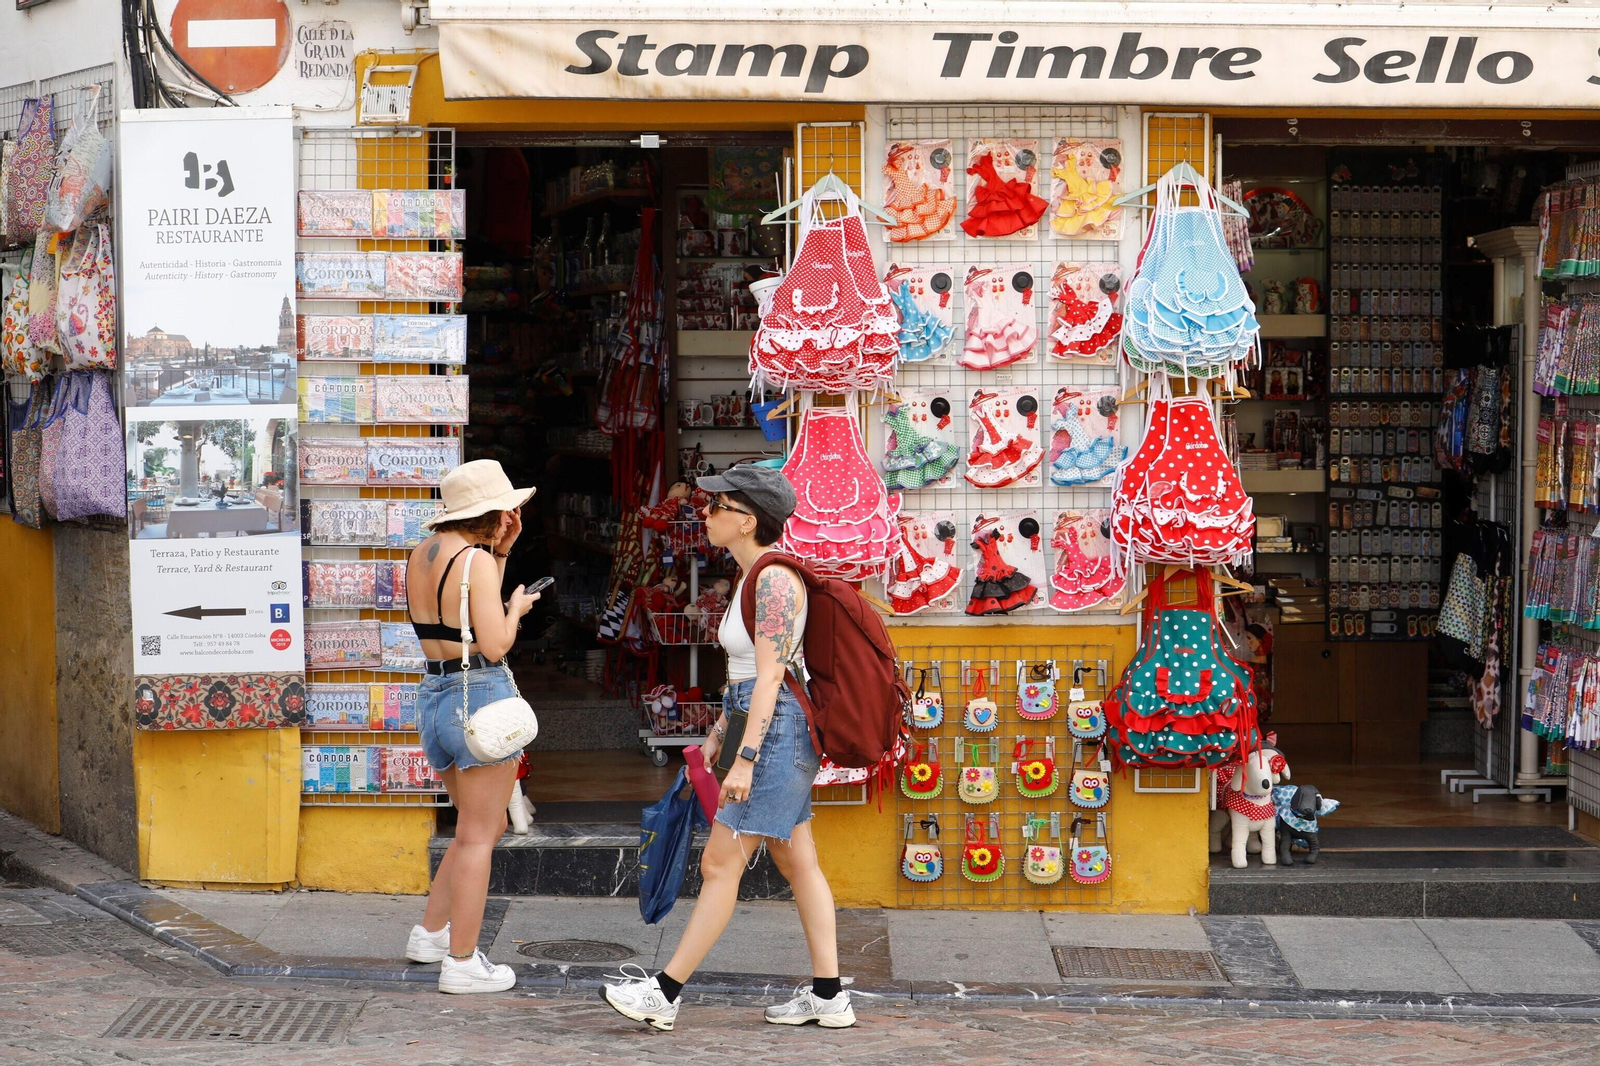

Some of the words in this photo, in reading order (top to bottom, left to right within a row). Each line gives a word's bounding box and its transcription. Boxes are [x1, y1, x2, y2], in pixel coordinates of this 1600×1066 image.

[297, 25, 327, 44] CALLE
[341, 29, 355, 41] LA
[304, 41, 346, 61] GRADA
[565, 30, 870, 94] Stamp
[932, 30, 1263, 81] Timbre
[1312, 36, 1534, 85] Sello
[299, 60, 349, 79] REDONDA
[147, 207, 199, 228] PAIRI
[205, 206, 273, 226] DAEZA
[156, 229, 264, 245] RESTAURANTE
[139, 260, 189, 270] Autenticidad
[195, 259, 227, 269] Historia
[232, 258, 283, 268] Gastronomía
[144, 271, 189, 282] Autenticity
[194, 271, 224, 281] History
[230, 270, 278, 280] Gastronomy
[314, 383, 365, 394] CÓRDOBA
[150, 549, 188, 558] Terraza,
[190, 548, 214, 557] Patio
[216, 550, 222, 559] y
[224, 547, 280, 556] Restaurante
[156, 565, 191, 574] Terrace,
[193, 564, 213, 573] Yard
[214, 563, 223, 573] &
[225, 563, 273, 573] Restaurant
[378, 595, 393, 603] ESP
[389, 690, 417, 701] CÓRD
[308, 752, 360, 763] CÓRDOBA
